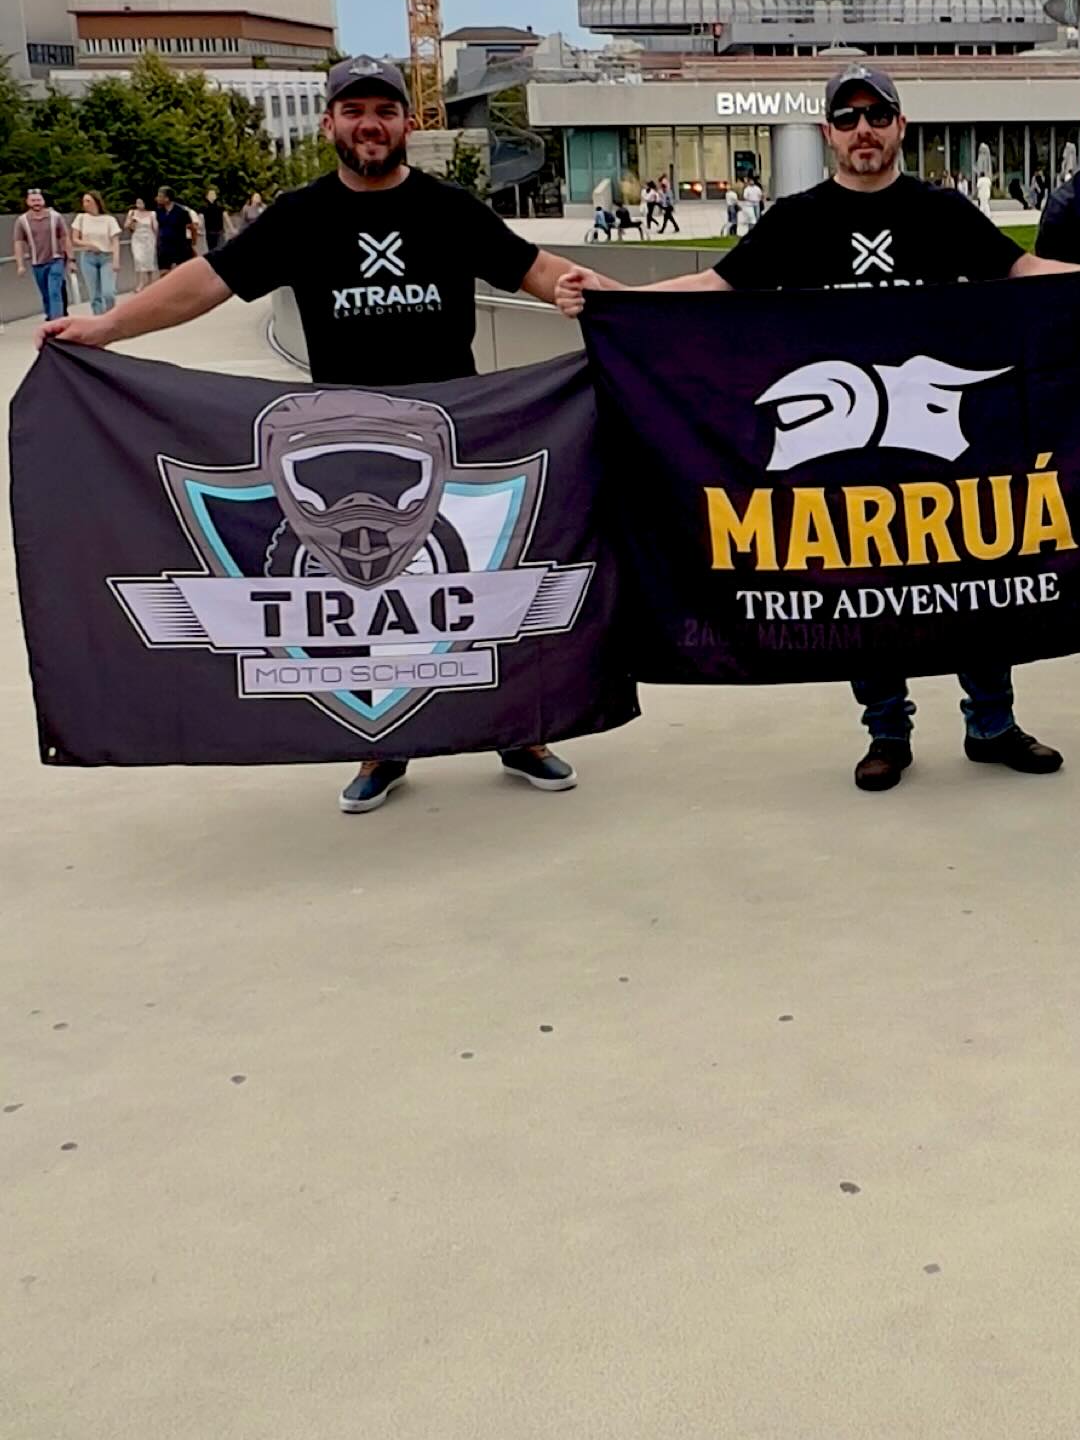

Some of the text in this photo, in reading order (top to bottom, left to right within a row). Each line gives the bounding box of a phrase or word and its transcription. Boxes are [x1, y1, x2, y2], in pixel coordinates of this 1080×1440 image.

[716, 91, 781, 116] BMW
[332, 283, 442, 310] XTRADA
[704, 452, 1079, 571] MARRUÁ
[250, 586, 475, 638] TRAC
[736, 572, 1062, 621] TRIP ADVENTURE
[255, 661, 479, 685] MOTO SCHOOL
